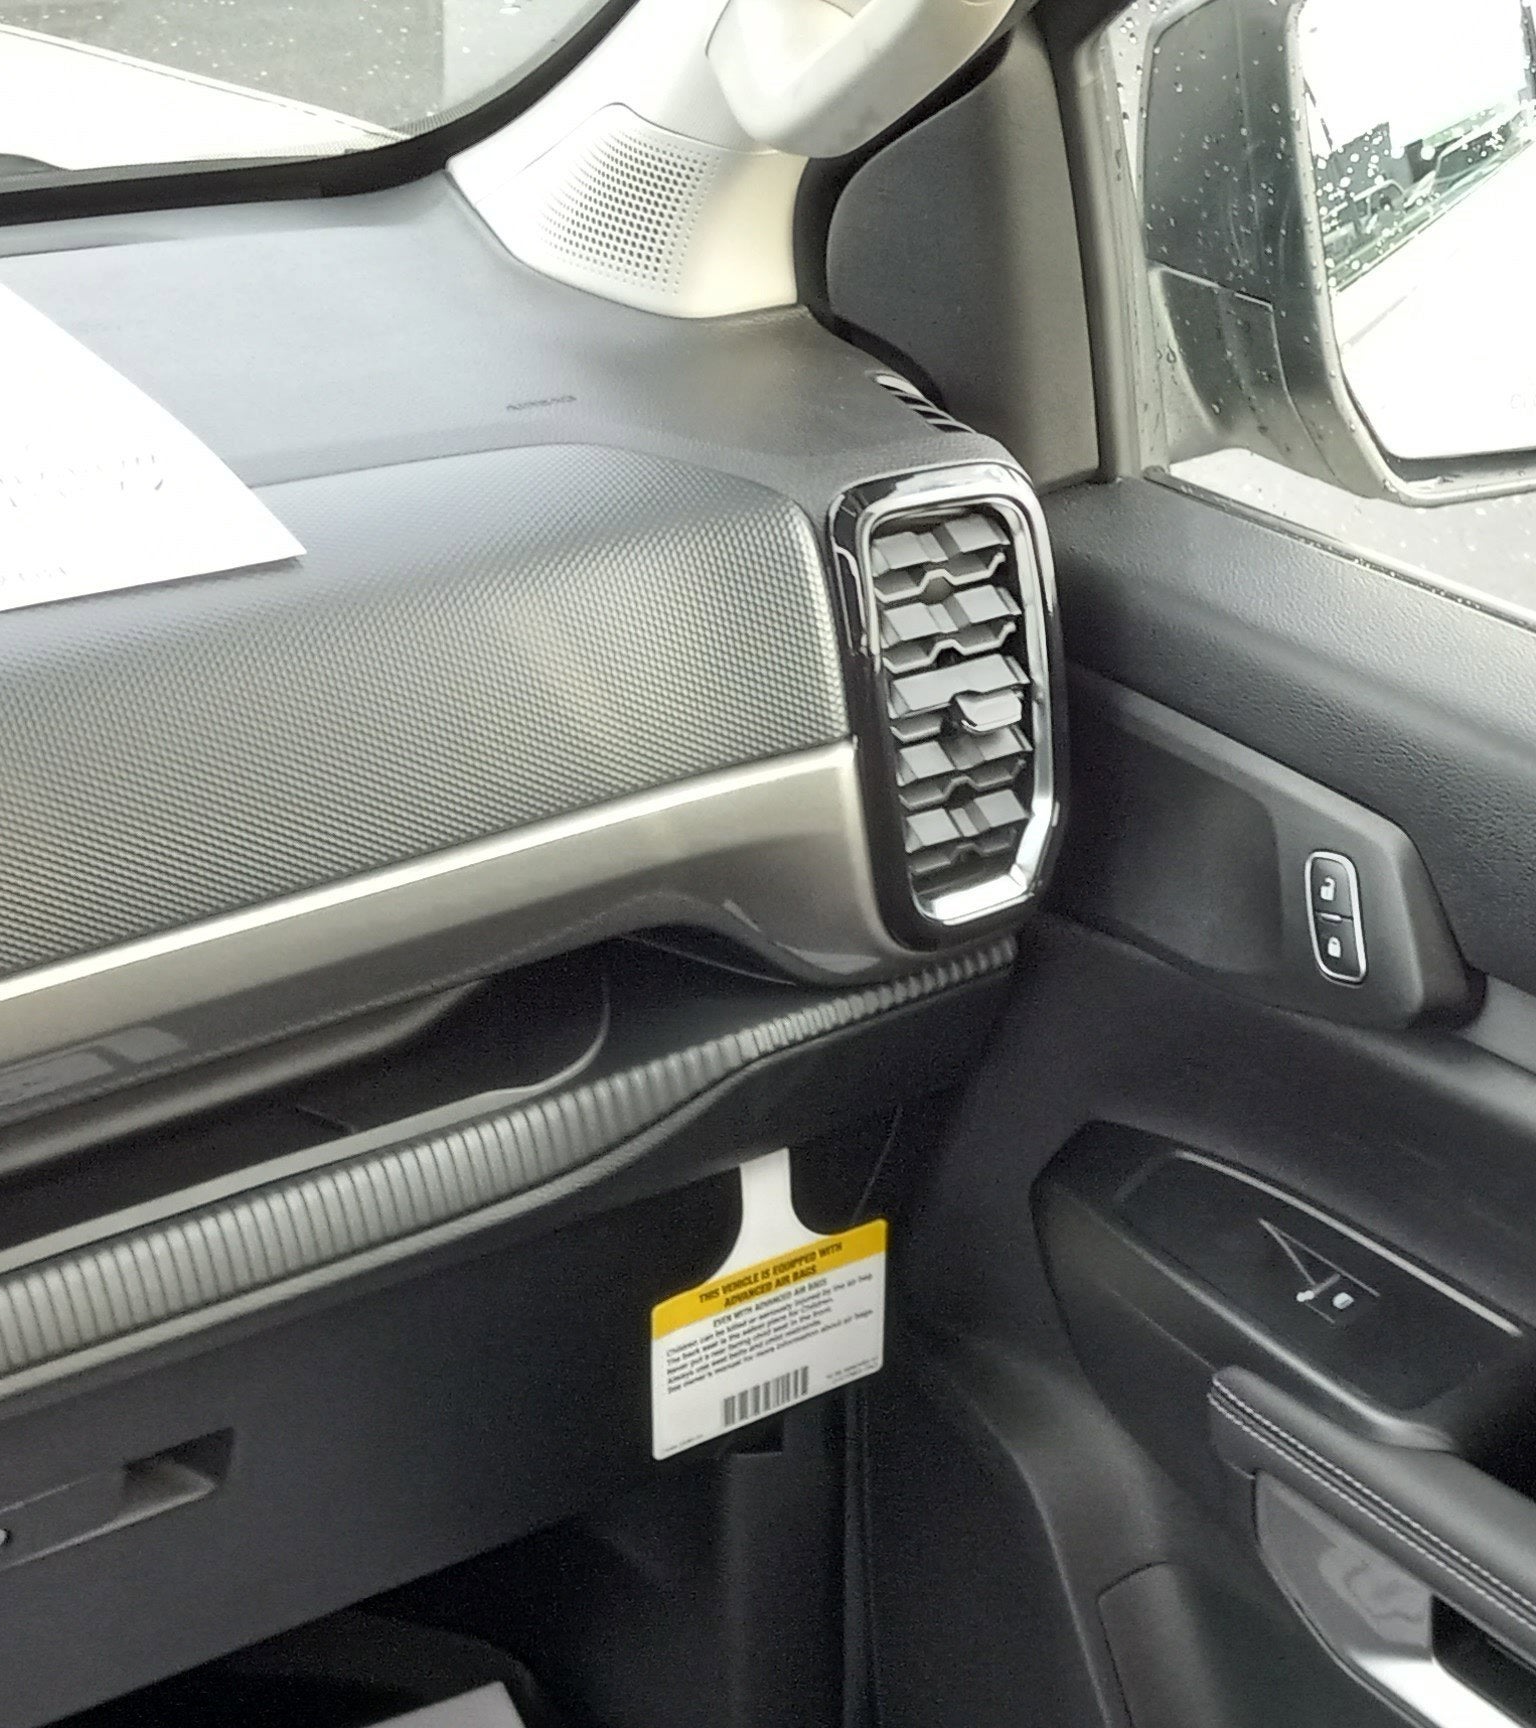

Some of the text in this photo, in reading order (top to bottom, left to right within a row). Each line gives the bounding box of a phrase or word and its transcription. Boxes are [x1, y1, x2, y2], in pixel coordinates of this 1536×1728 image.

[699, 1242, 843, 1303] THIS VEHICLE IS EQUIPPED WITH
[724, 1264, 817, 1307] ADVANCED AIR BAGS
[713, 1278, 828, 1328] EVEN WITH ADVANCED AIR BAGS
